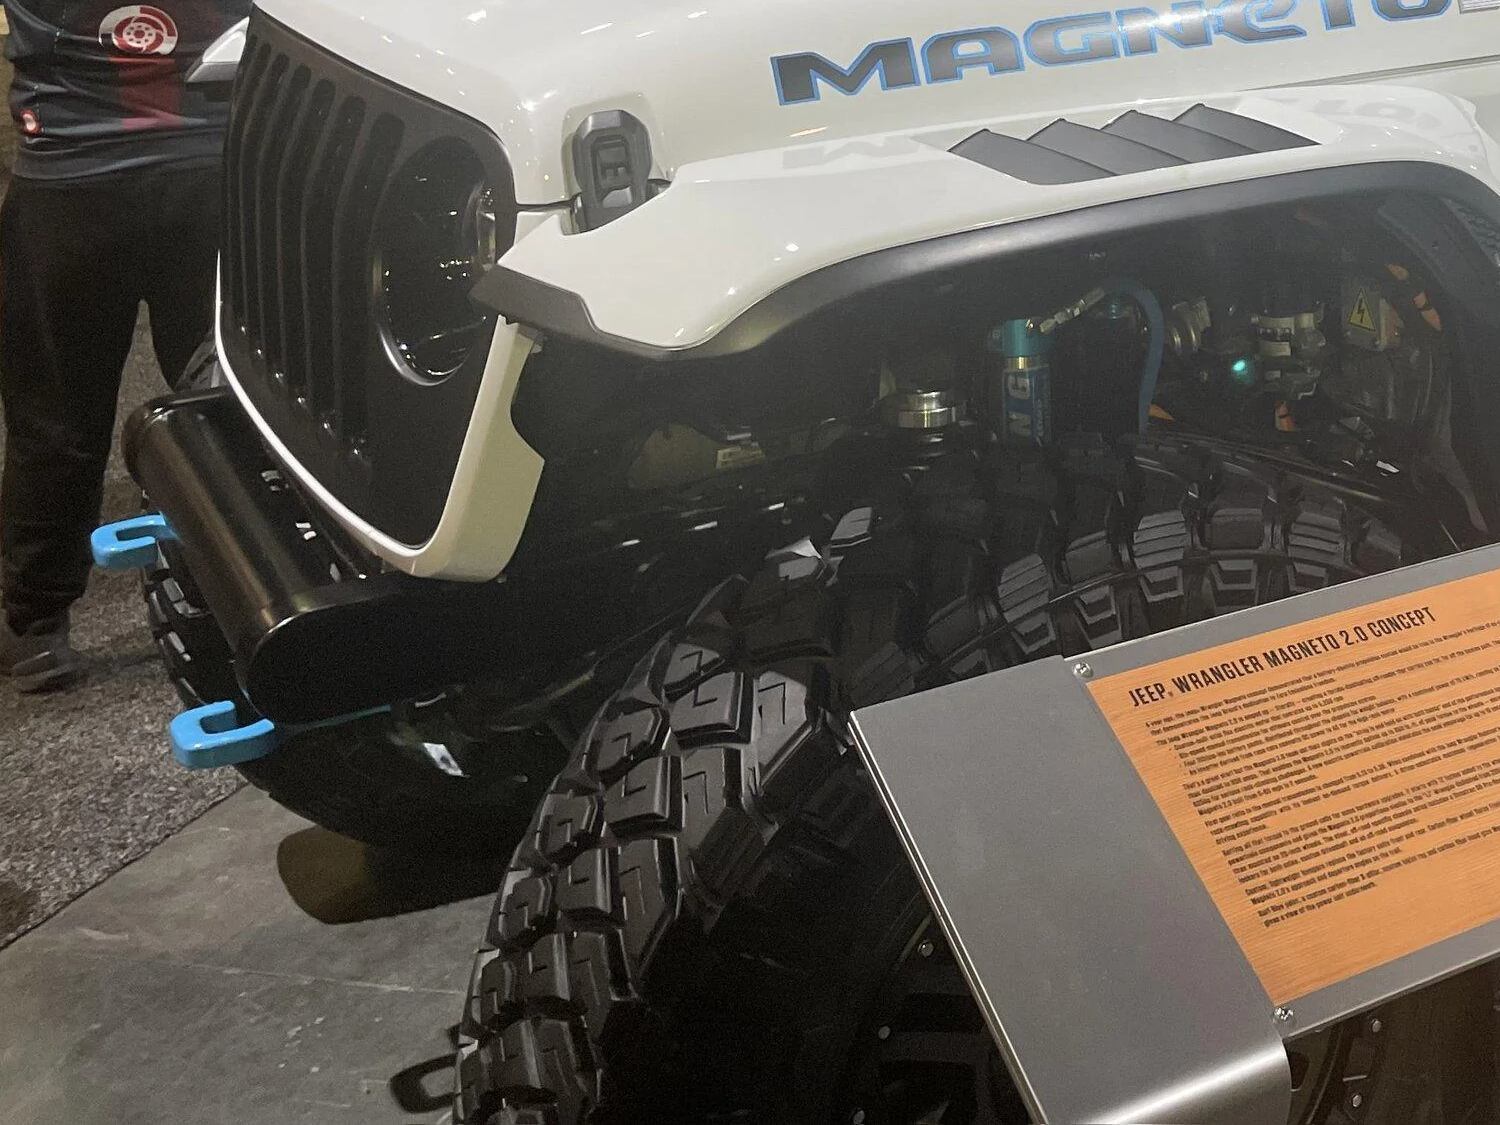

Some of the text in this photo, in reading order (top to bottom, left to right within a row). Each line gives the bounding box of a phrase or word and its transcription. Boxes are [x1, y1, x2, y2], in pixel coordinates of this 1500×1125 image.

[1172, 656, 1264, 694] WRANGLER
[1263, 634, 1341, 668] MAGNETO
[1340, 625, 1369, 646] 2.0
[1370, 606, 1437, 638] CONCEPT
